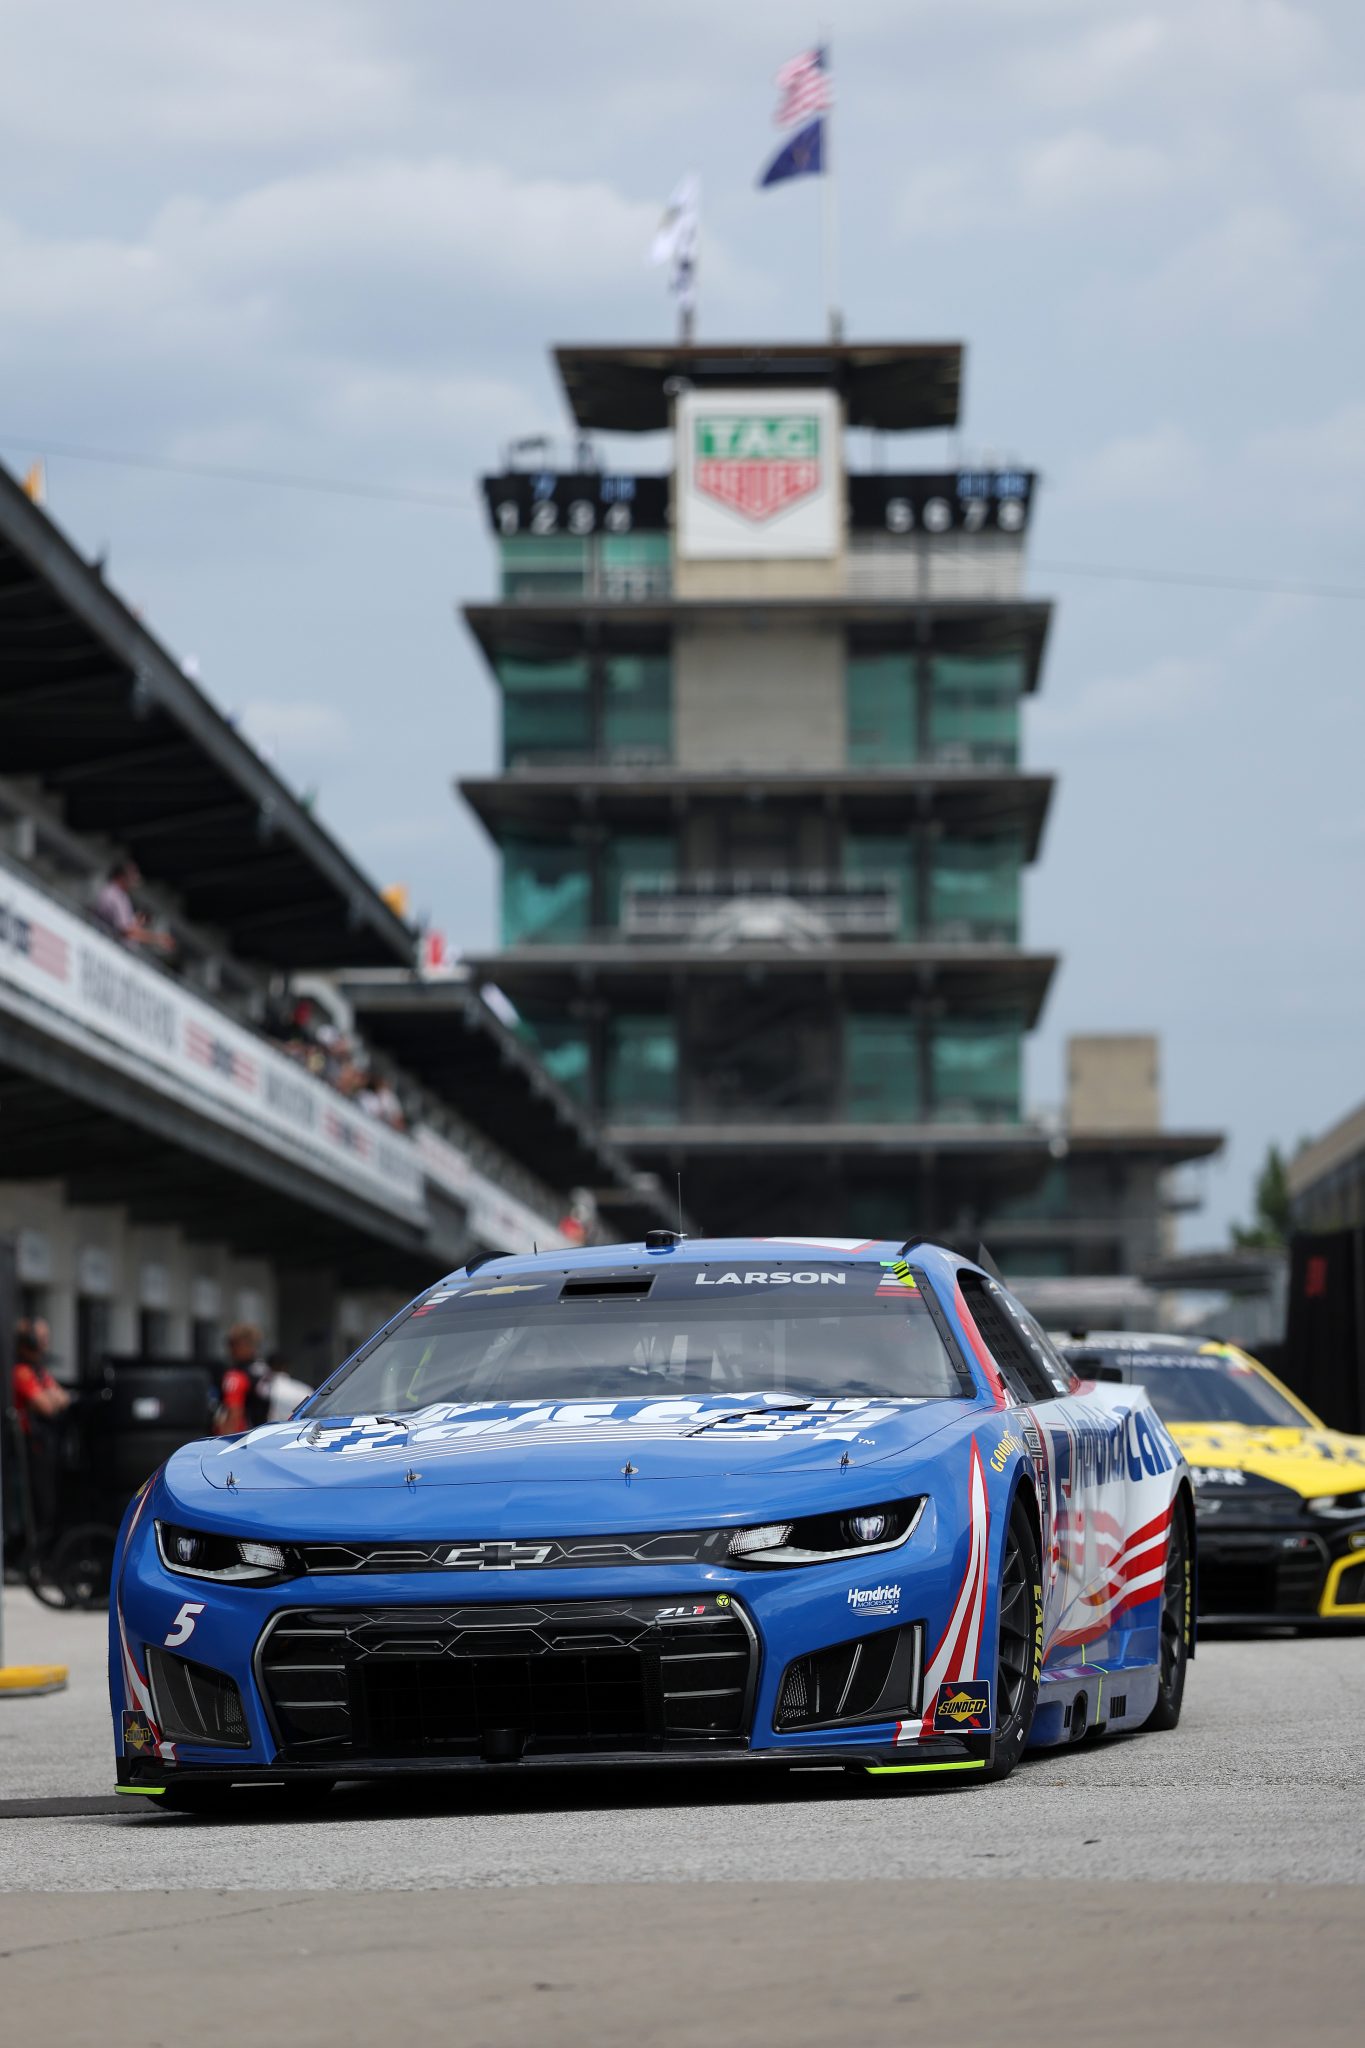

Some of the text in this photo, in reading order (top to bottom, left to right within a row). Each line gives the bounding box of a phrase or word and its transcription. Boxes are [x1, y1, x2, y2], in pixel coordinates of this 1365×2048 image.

[497, 501, 519, 536] 1
[531, 499, 558, 535] 2
[567, 499, 595, 535] 3
[886, 498, 914, 533] 5
[960, 497, 988, 533] 7
[695, 1272, 846, 1285] LARSON
[857, 1437, 876, 1446] TM
[990, 1436, 1024, 1473] GOODY
[847, 1584, 902, 1607] Hendrick
[857, 1598, 900, 1608] MOTORSPORTS
[655, 1605, 706, 1618] ZL1
[164, 1602, 206, 1647] 5
[1032, 1584, 1044, 1686] EAGLE
[940, 1700, 986, 1714] SUNOCO
